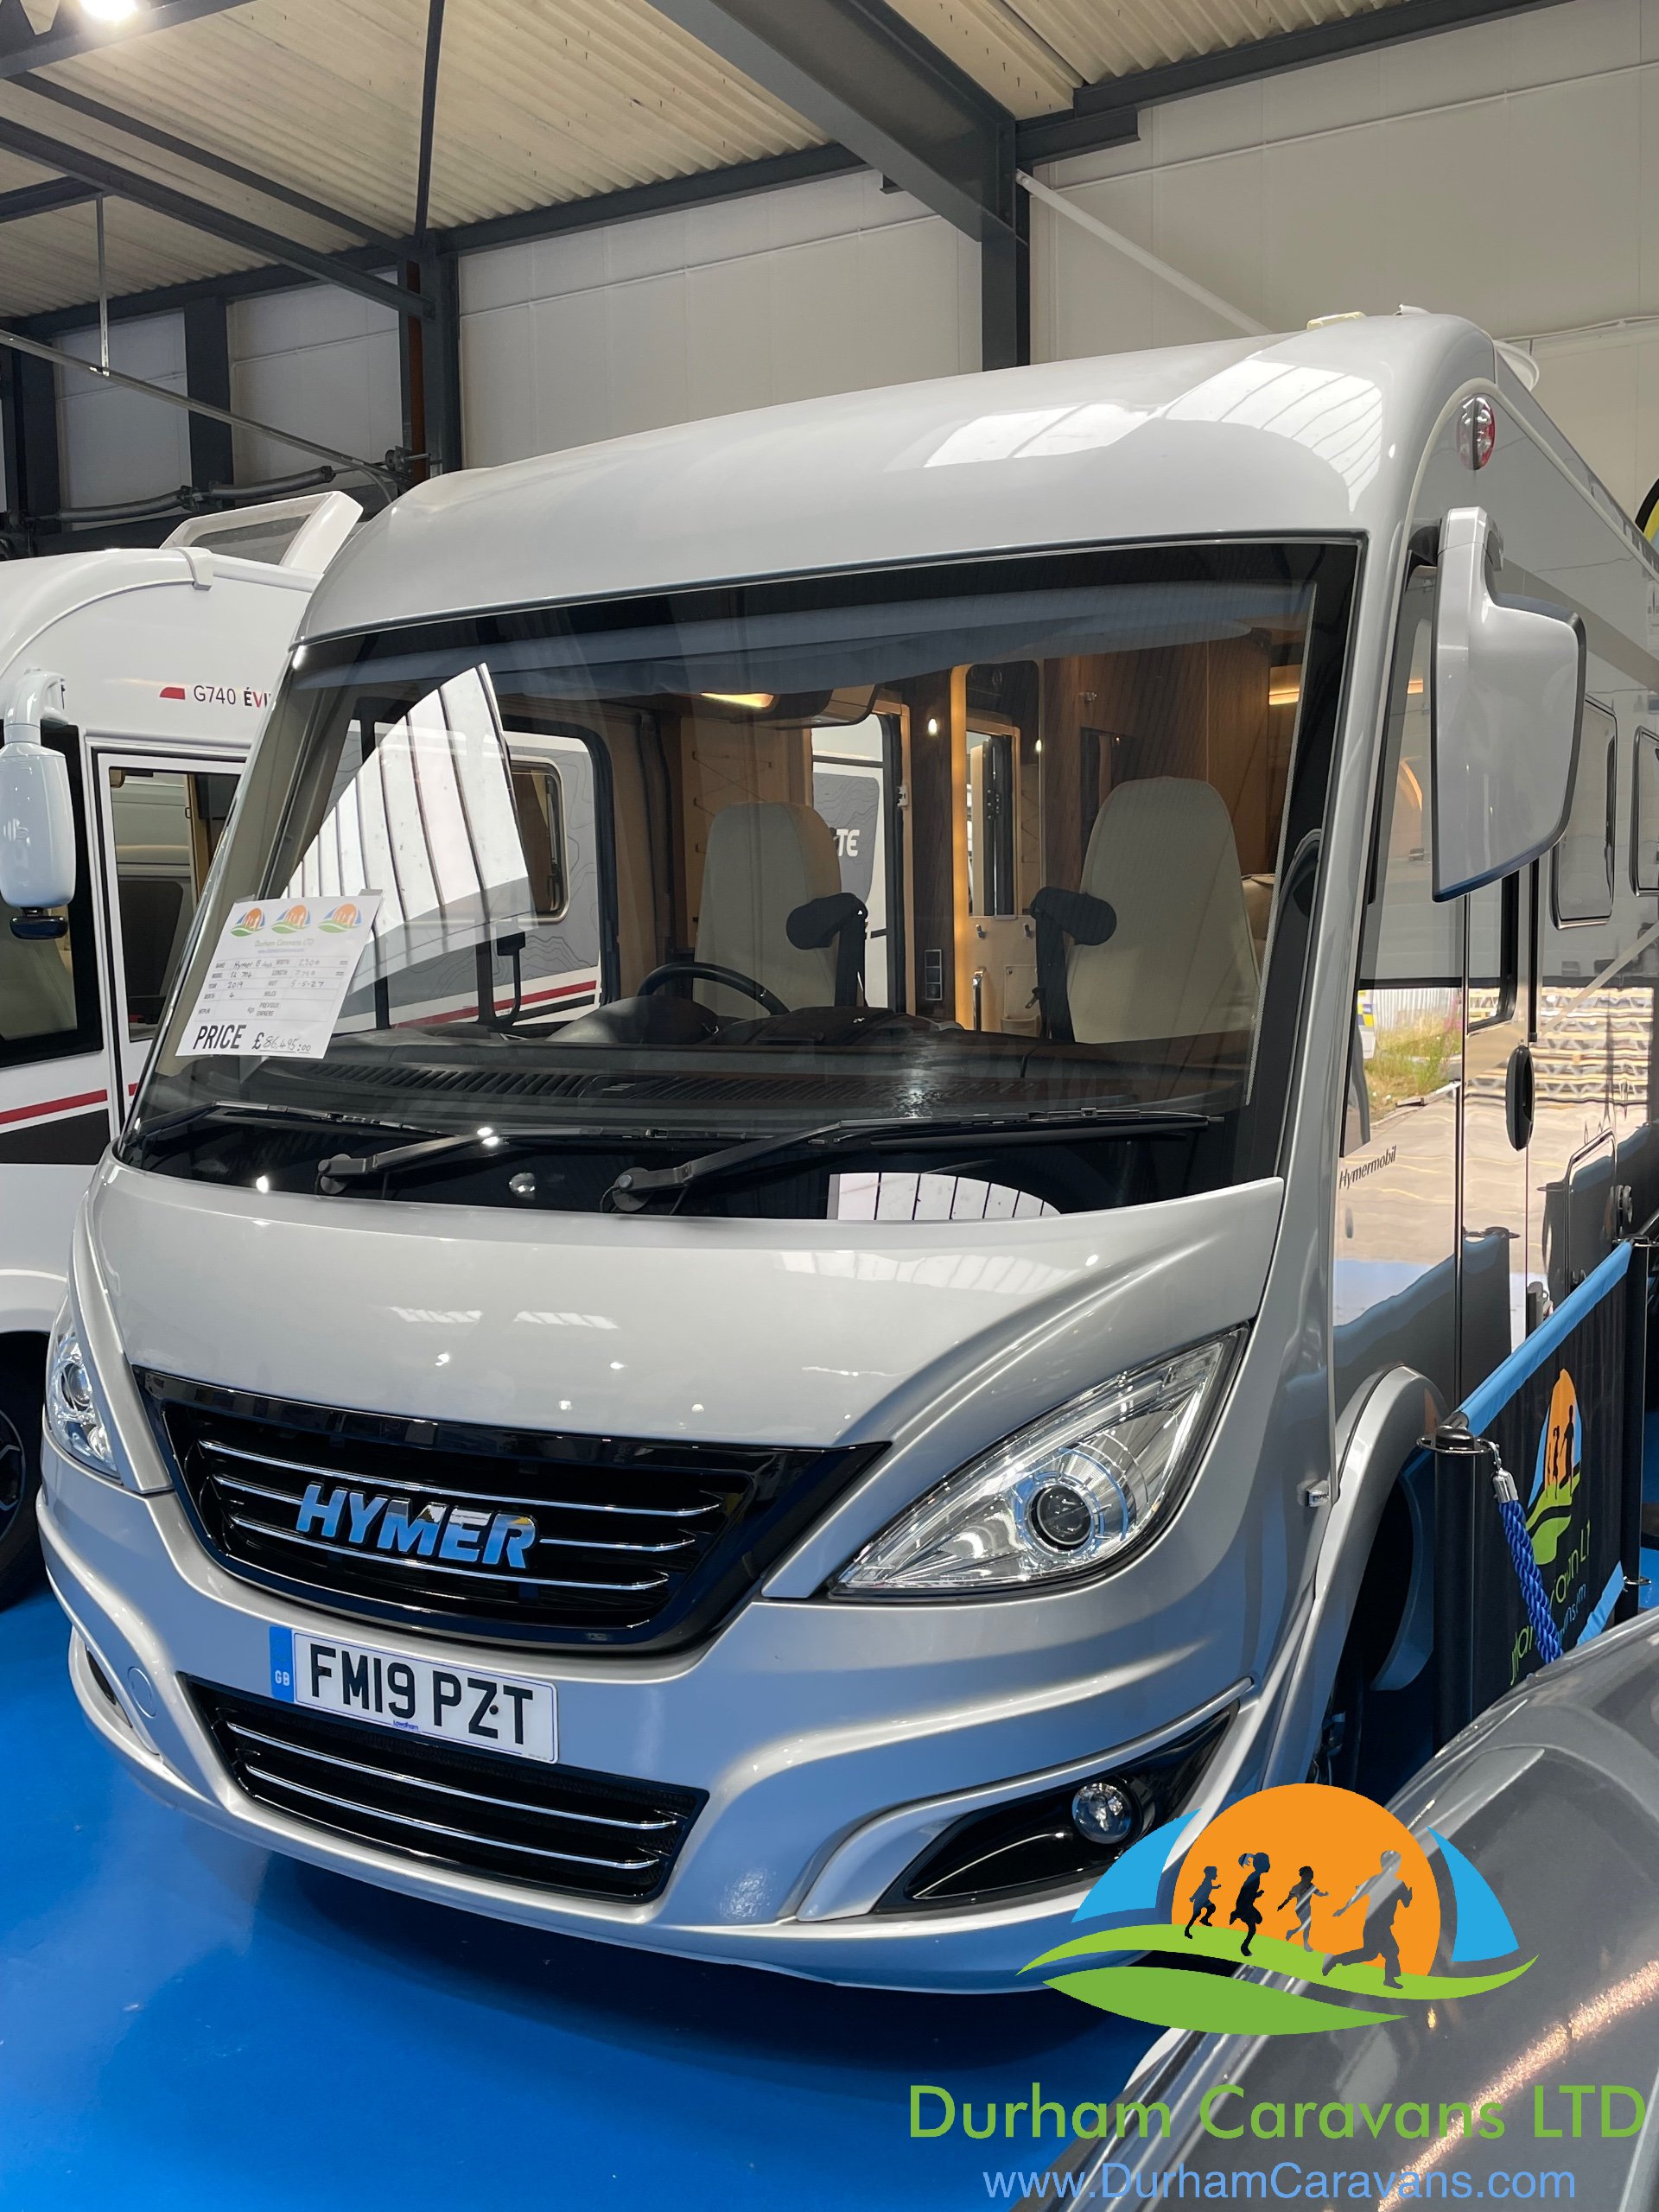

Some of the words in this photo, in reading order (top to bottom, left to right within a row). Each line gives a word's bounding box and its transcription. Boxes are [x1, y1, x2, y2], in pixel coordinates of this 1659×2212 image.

[194, 685, 236, 705] G740
[244, 687, 270, 708] ÉVI
[833, 828, 861, 857] TE
[193, 1024, 247, 1050] PRICE
[1338, 1144, 1397, 1191] Hymermobil
[296, 1482, 537, 1570] HYMER
[274, 1670, 290, 1687] GB
[310, 1643, 416, 1719] FM19
[432, 1669, 533, 1745] PZT
